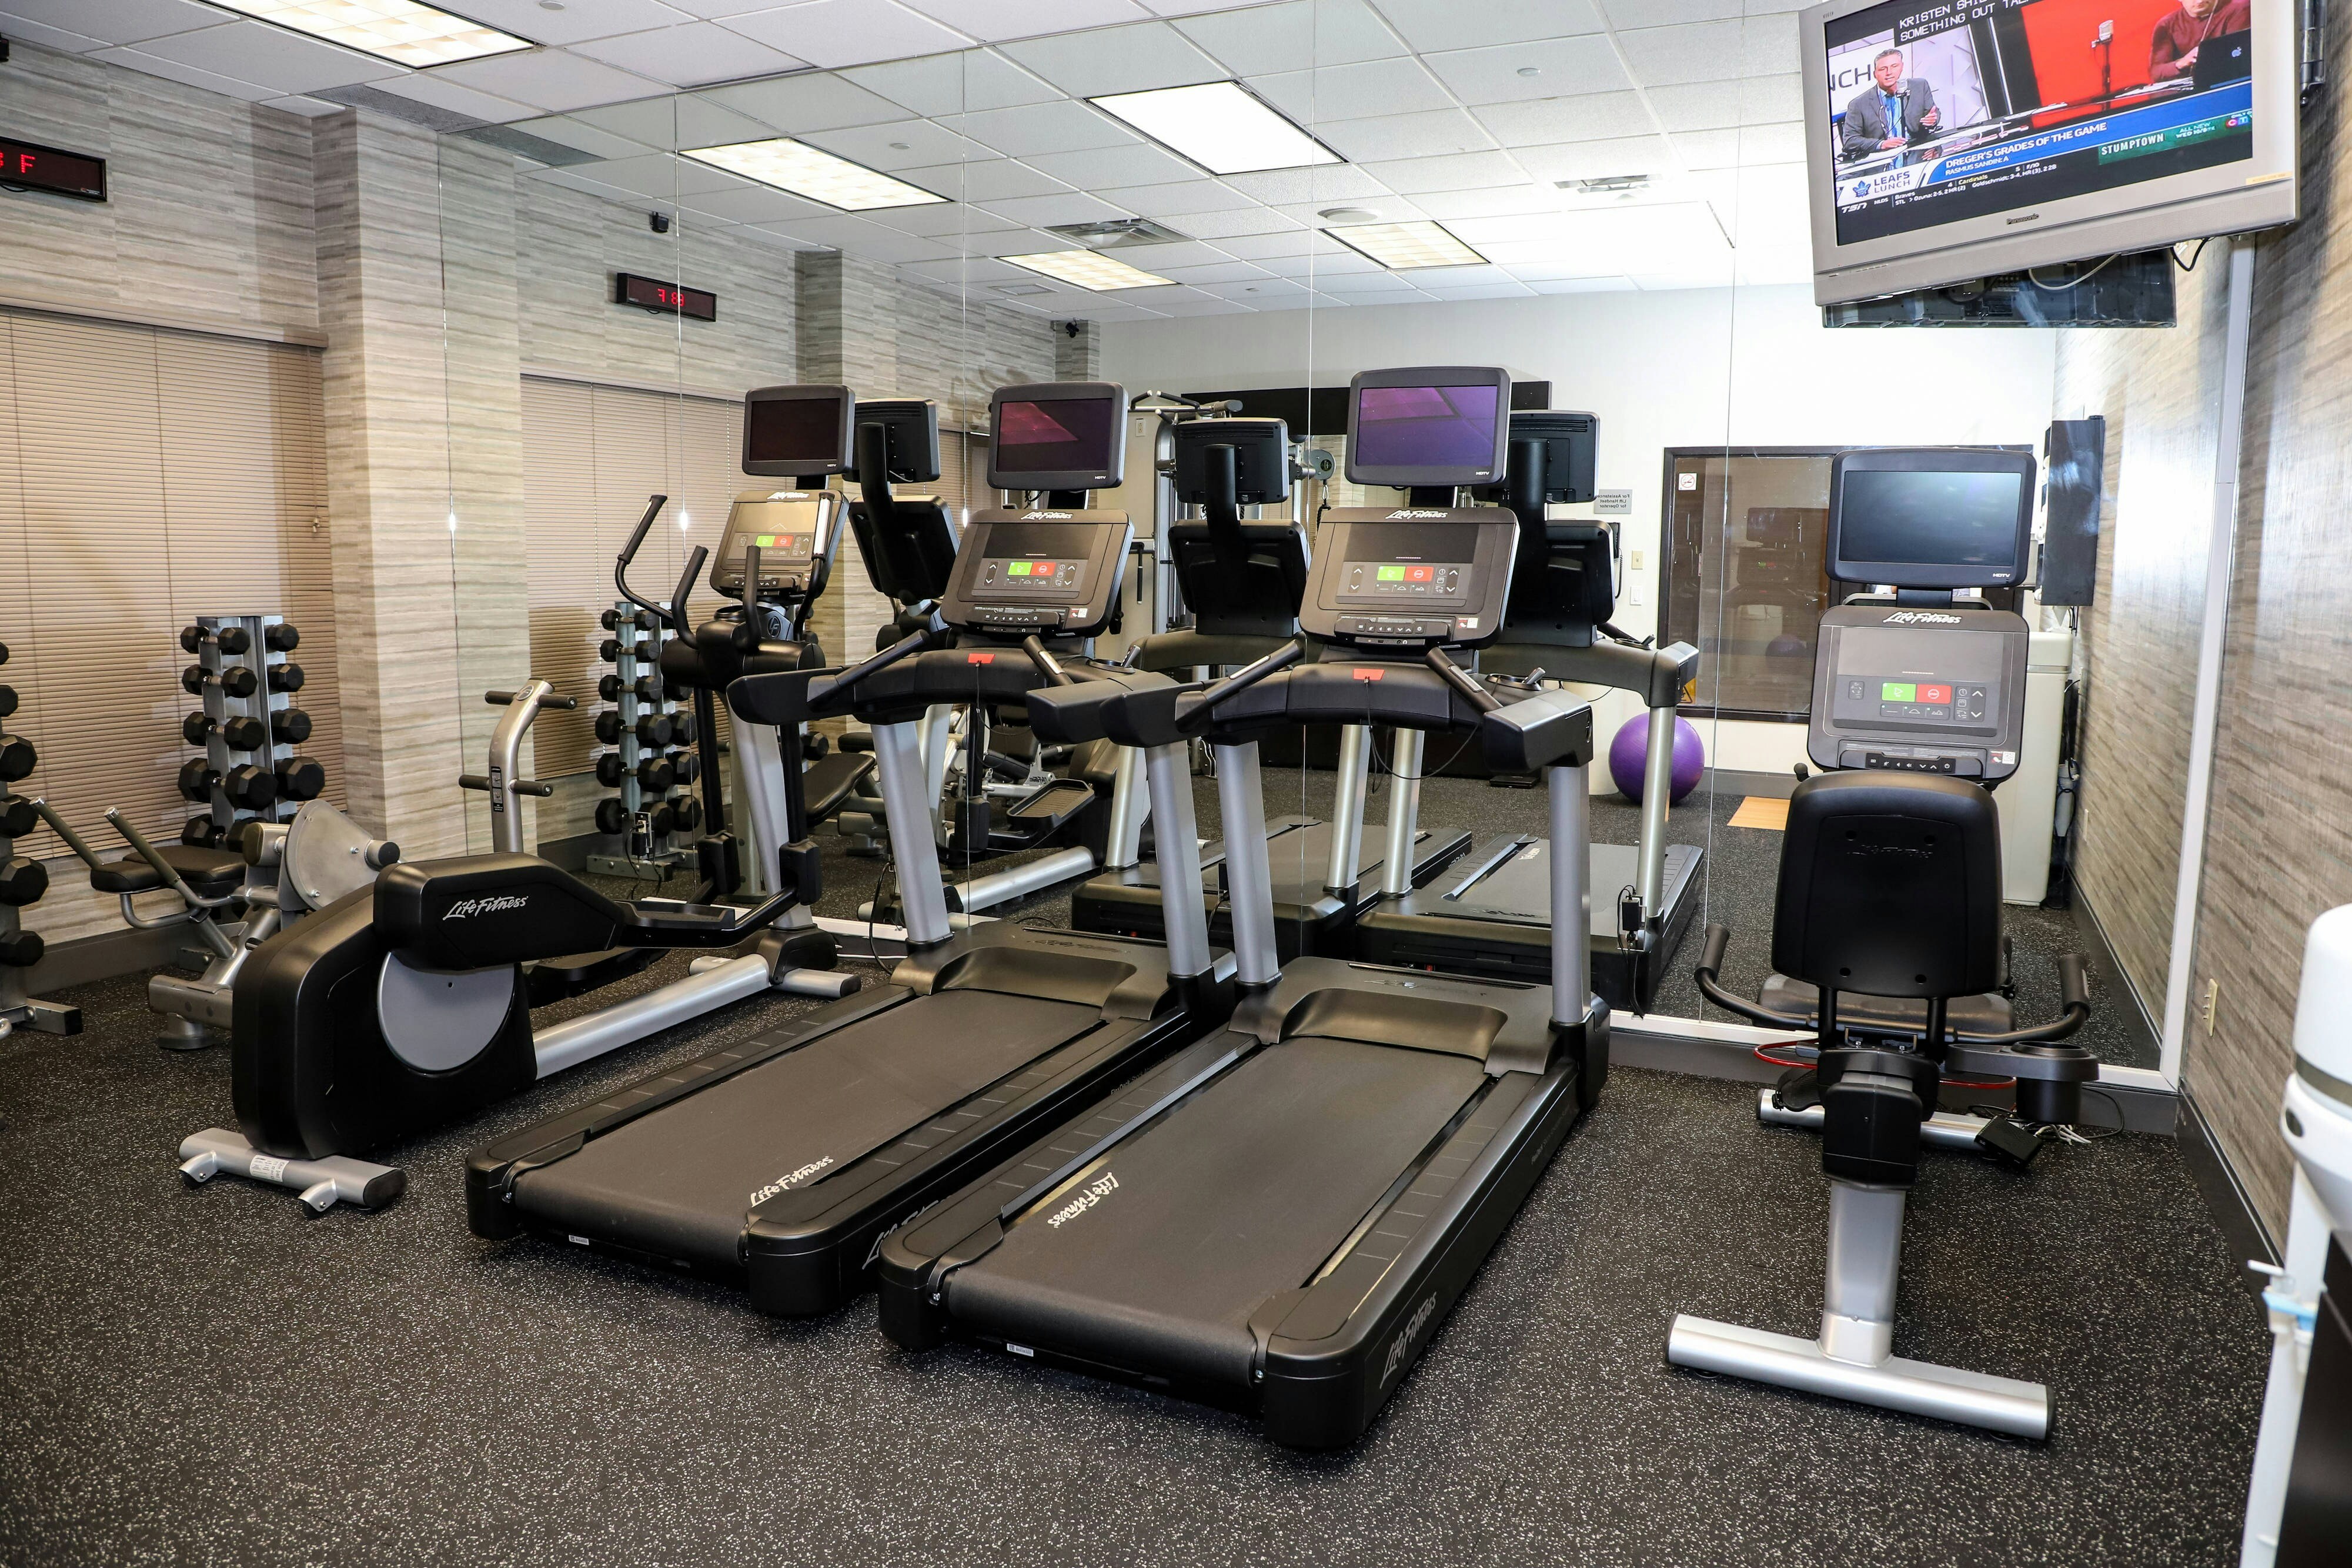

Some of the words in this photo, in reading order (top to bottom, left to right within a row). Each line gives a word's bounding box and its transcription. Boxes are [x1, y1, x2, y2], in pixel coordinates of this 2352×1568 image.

[1900, 5, 1950, 29] KRISTEN
[1900, 13, 1966, 42] SOMETHING
[1972, 3, 1995, 18] OUT
[1946, 149, 1993, 169] DREGER'S
[1994, 138, 2034, 157] GRADES
[2035, 135, 2050, 148] OF
[2049, 131, 2074, 143] THE
[2074, 122, 2107, 137] GAME
[2101, 133, 2165, 156] STUMPTOWN
[21, 154, 35, 173] F
[1946, 164, 1974, 176] RASMUS
[1874, 171, 1910, 186] LEAFS
[1959, 174, 1988, 185] Cardinals
[1972, 174, 2010, 188] Goldschmidt:
[1874, 179, 1910, 193] LUNCH
[1895, 192, 1916, 200] Braves
[1842, 202, 1867, 213] TSN
[2006, 213, 2039, 225] Panasonic
[443, 899, 477, 921] Life
[474, 896, 529, 917] Fitness
